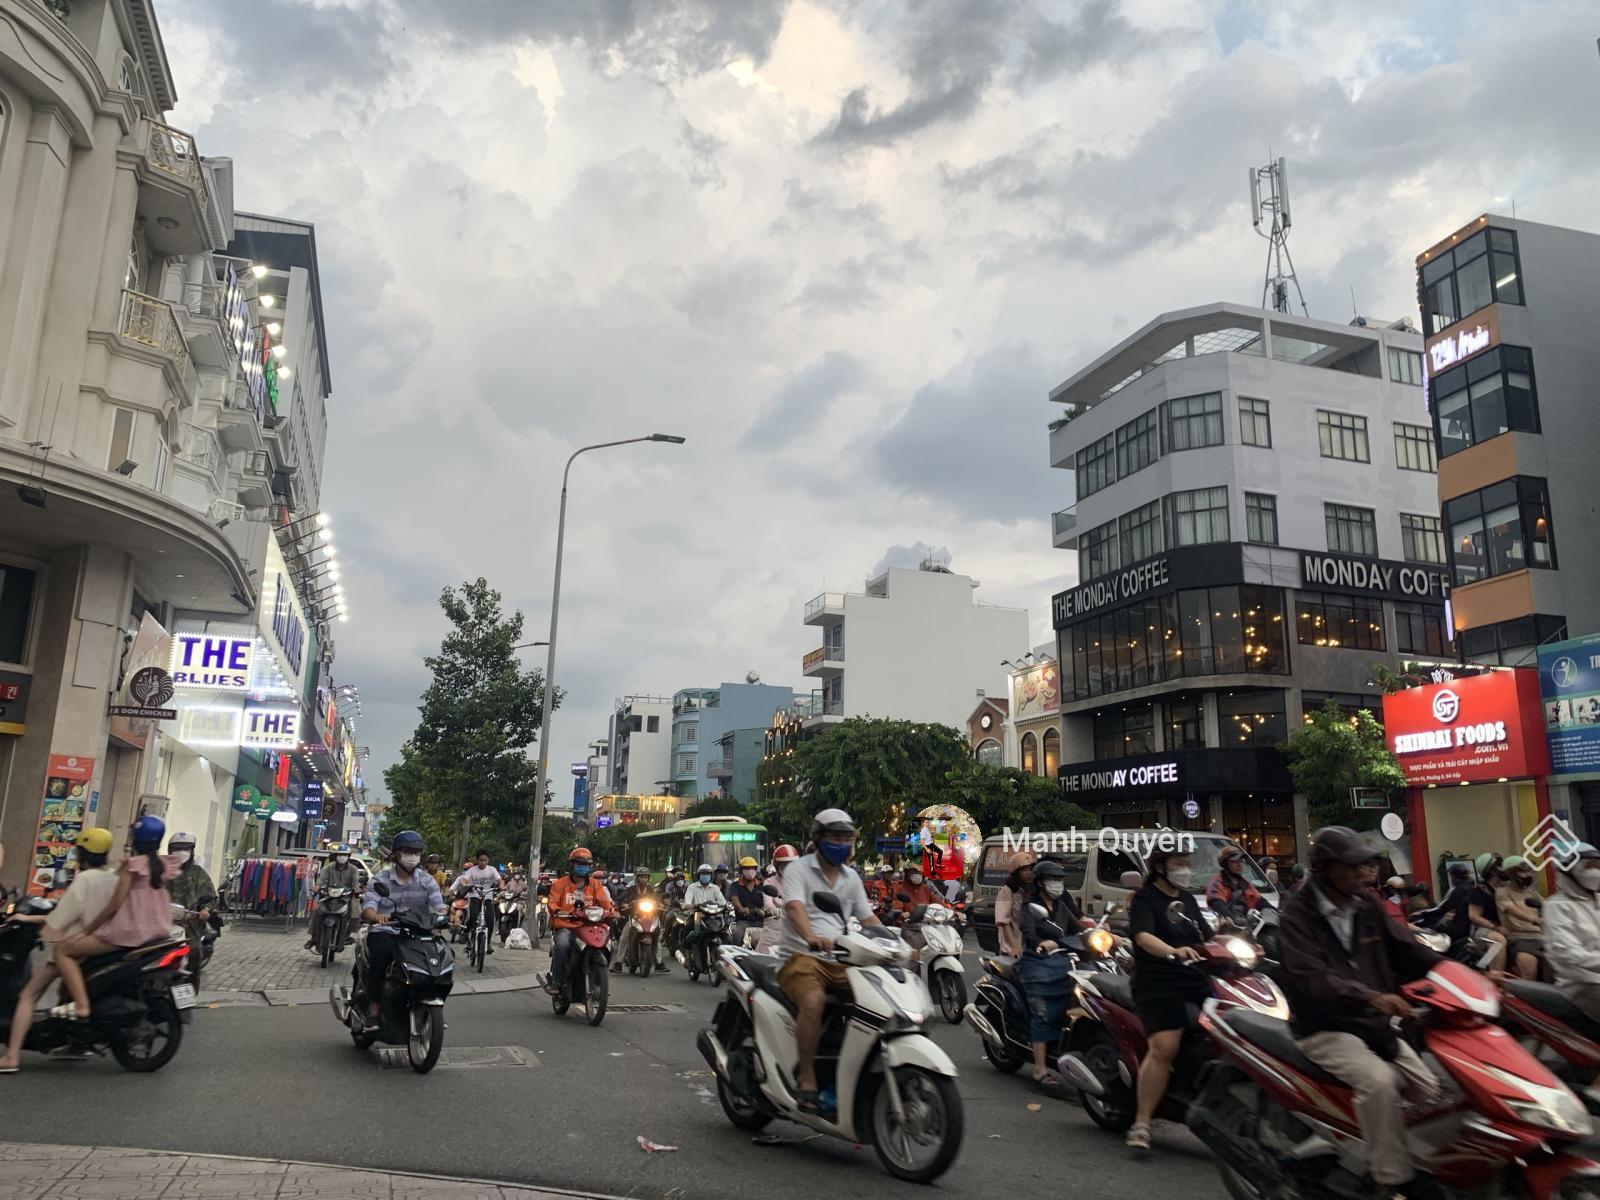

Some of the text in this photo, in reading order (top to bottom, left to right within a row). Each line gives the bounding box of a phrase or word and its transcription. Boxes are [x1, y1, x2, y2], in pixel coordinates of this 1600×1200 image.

[1304, 555, 1393, 591] MONDAY
[1053, 558, 1169, 621] THE MONDAY COFFEE
[178, 636, 251, 671] THE
[173, 672, 246, 688] BLUES
[139, 709, 173, 717] CHICKEN
[249, 711, 297, 735] THE
[1455, 722, 1506, 747] FOODS
[1475, 743, 1509, 754] .com.vn
[1060, 763, 1178, 792] THE MONDAY COFFEE
